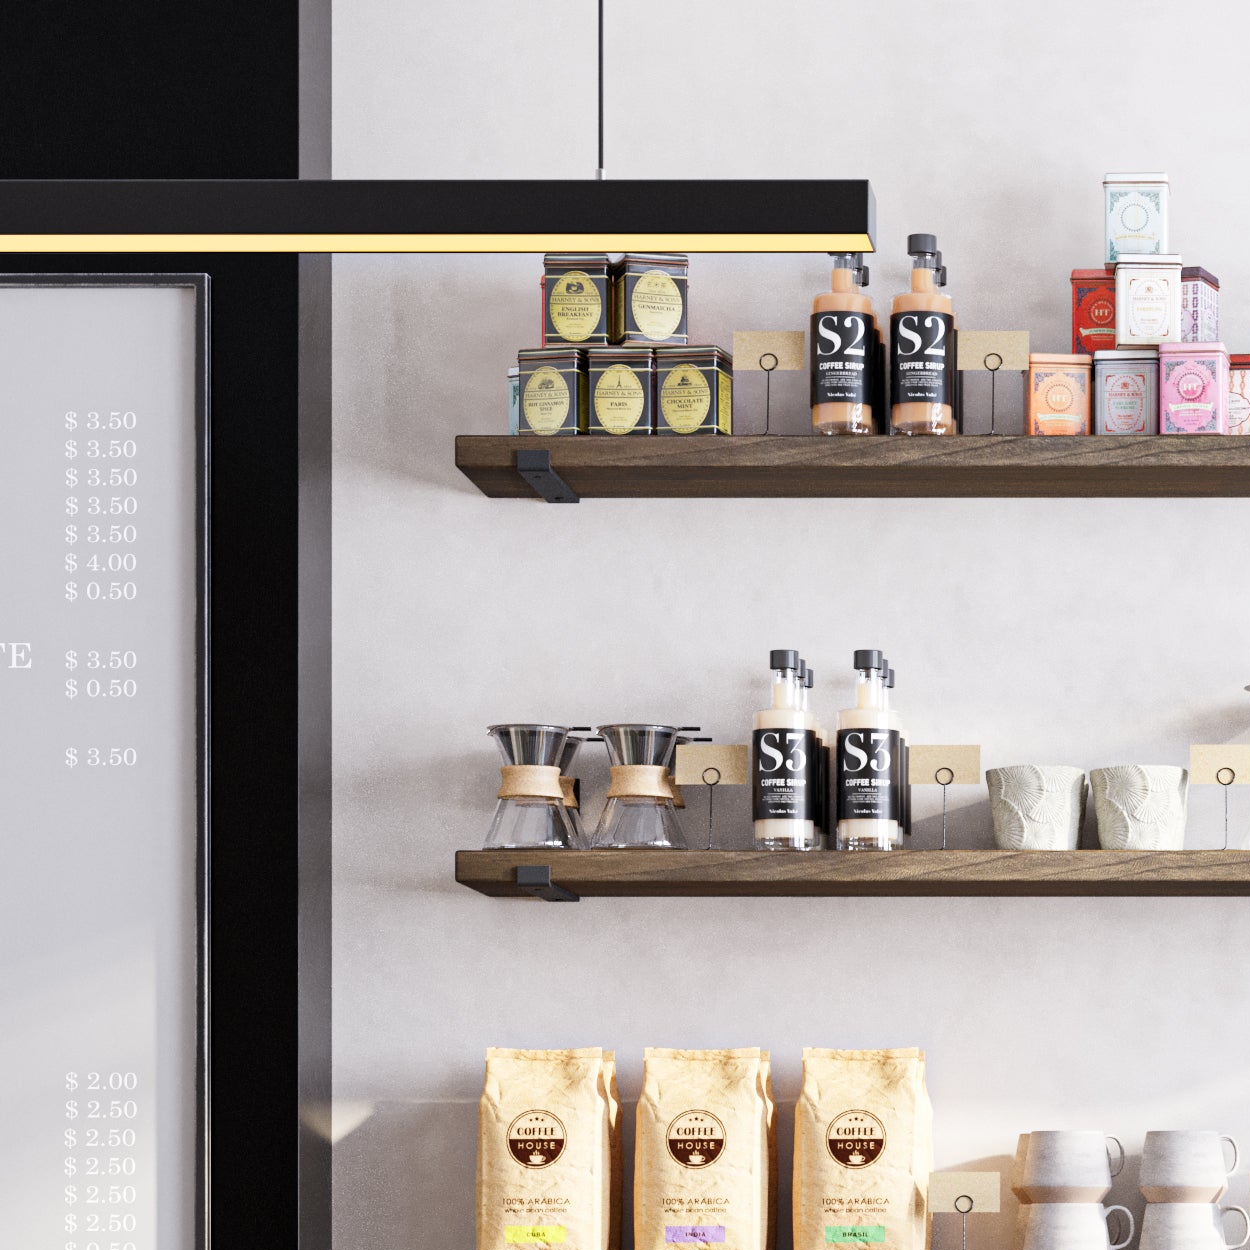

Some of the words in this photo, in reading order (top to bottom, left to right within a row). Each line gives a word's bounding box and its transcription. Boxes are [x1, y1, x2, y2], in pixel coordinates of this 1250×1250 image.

[817, 315, 865, 356] S2
[897, 315, 946, 356] S2
[819, 361, 843, 370] COFFEE
[900, 361, 924, 370] COFFEE
[65, 411, 77, 431] $
[87, 412, 136, 429] 3.50
[65, 440, 77, 460] $
[87, 440, 136, 457] 3.50
[66, 468, 78, 488] $
[88, 469, 137, 486] 3.50
[66, 496, 78, 517] $
[88, 497, 137, 514] 3.50
[65, 525, 77, 545] $
[88, 525, 136, 543] 3.50
[65, 553, 77, 573] $
[87, 554, 136, 571] 4.00
[66, 581, 77, 602] $
[87, 582, 136, 600] 0.50
[66, 650, 77, 671] $
[87, 651, 136, 668] 3.50
[66, 679, 78, 700] $
[87, 680, 136, 697] 0.50
[66, 747, 78, 768] $
[88, 748, 136, 765] 3.50
[759, 733, 807, 773] S3
[843, 733, 891, 773] S3
[761, 779, 786, 787] COFFEE
[845, 779, 870, 787] COFFEE
[66, 1072, 78, 1092] $
[88, 1072, 137, 1090] 2.00
[66, 1100, 78, 1120] $
[88, 1101, 137, 1120] 2.50
[64, 1128, 76, 1149] $
[86, 1129, 136, 1147] 2.50
[517, 1127, 556, 1135] COFFEE
[676, 1127, 716, 1135] COFFEE
[836, 1127, 876, 1135] COFFEE
[517, 1142, 556, 1150] HOUSE
[677, 1142, 715, 1150] HOUSE
[837, 1142, 875, 1150] HOUSE
[64, 1157, 76, 1178] $
[86, 1157, 135, 1175] 2.50
[65, 1185, 77, 1207] $
[86, 1186, 136, 1203] 2.50
[65, 1213, 77, 1234] $
[86, 1214, 136, 1231] 2.50
